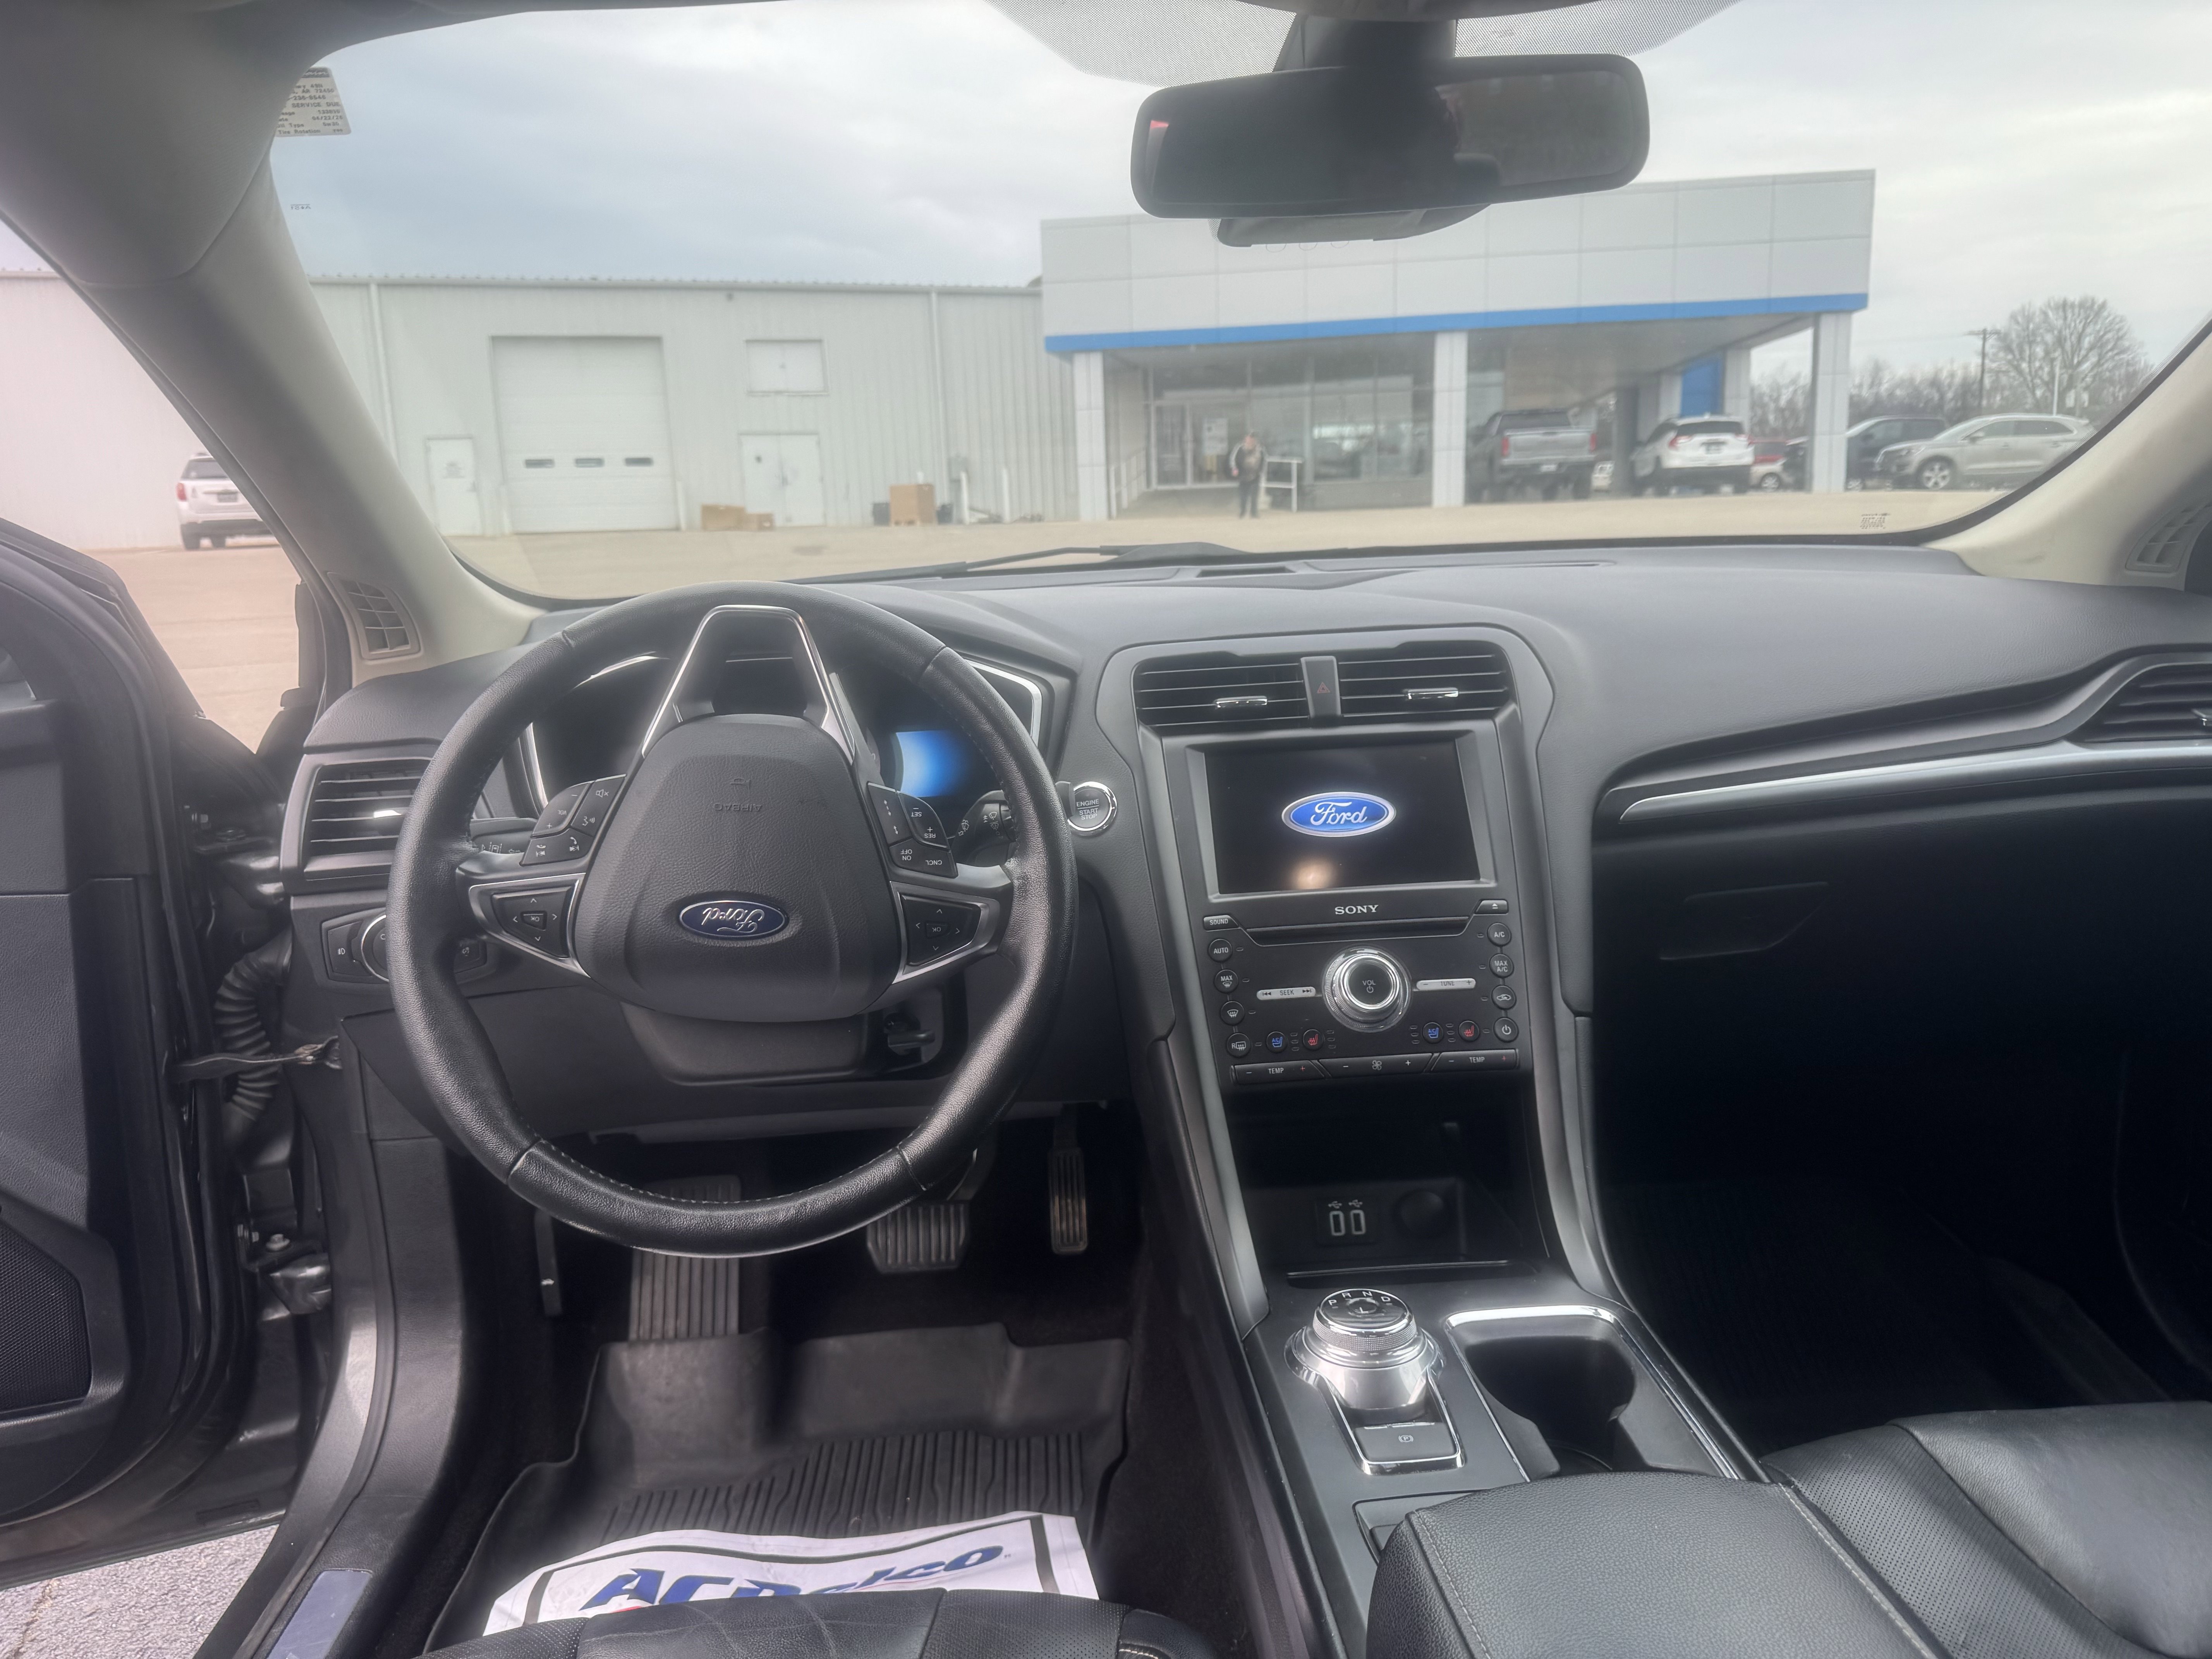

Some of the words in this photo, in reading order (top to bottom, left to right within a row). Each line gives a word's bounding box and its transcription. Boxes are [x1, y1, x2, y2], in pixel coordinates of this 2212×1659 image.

[714, 803, 763, 812] AIRBAG
[1310, 802, 1367, 825] Ford
[1334, 905, 1379, 915] SONY
[701, 908, 764, 933] Ford
[1209, 917, 1228, 926] SOUND
